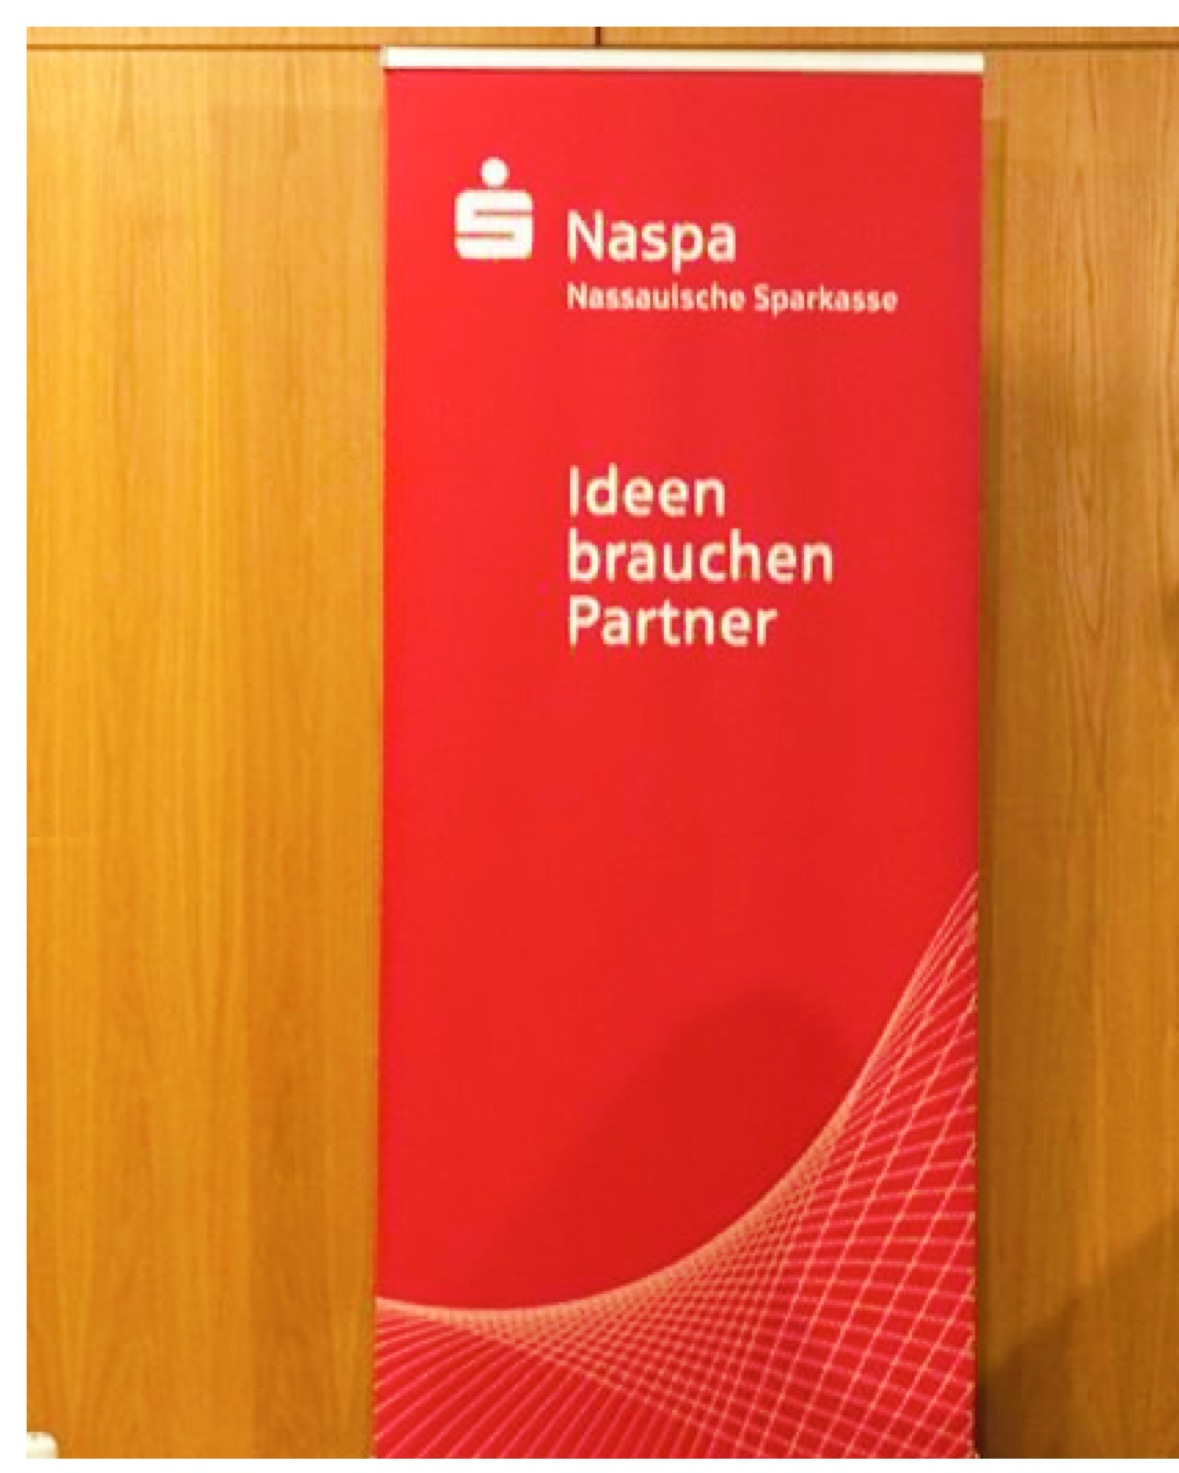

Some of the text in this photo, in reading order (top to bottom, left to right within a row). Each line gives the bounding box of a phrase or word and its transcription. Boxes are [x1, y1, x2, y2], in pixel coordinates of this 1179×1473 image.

[567, 210, 736, 273] Naspa
[566, 282, 898, 317] Nassauische Sparkasse
[569, 463, 725, 517] Ideen
[569, 527, 833, 583] brauchen
[569, 595, 778, 647] Partner
